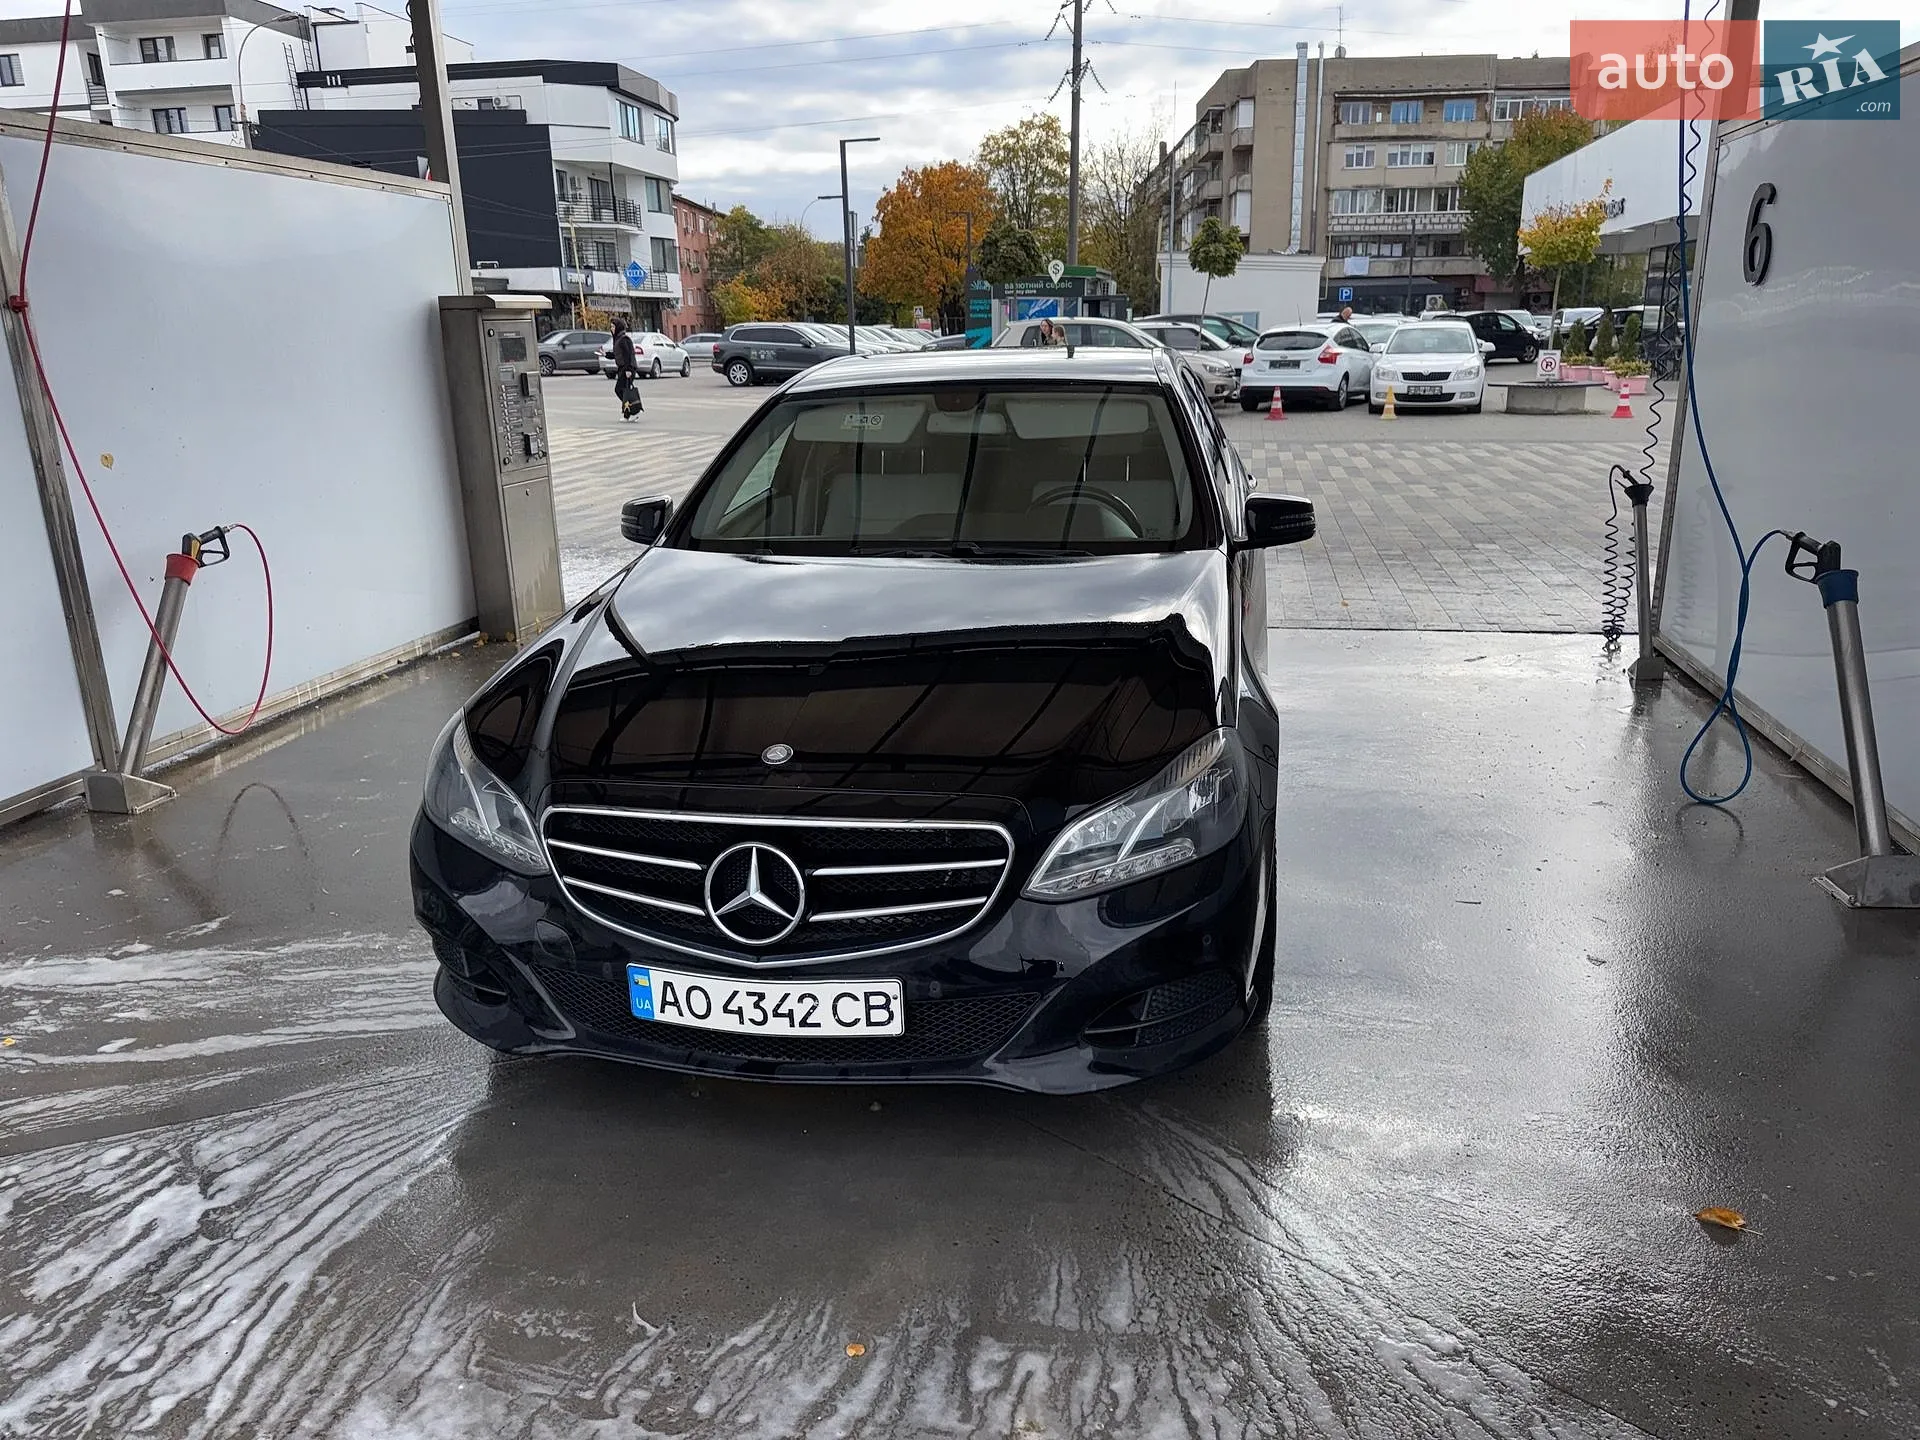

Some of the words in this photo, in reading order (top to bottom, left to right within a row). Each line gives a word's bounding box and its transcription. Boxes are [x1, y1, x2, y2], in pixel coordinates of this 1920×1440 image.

[1742, 182, 1778, 286] 6
[1004, 281, 1044, 290] ваютний
[1342, 289, 1350, 300] P
[635, 1000, 653, 1011] UA
[659, 980, 712, 1020] AO
[722, 989, 822, 1028] 4342
[831, 990, 895, 1028] CB
